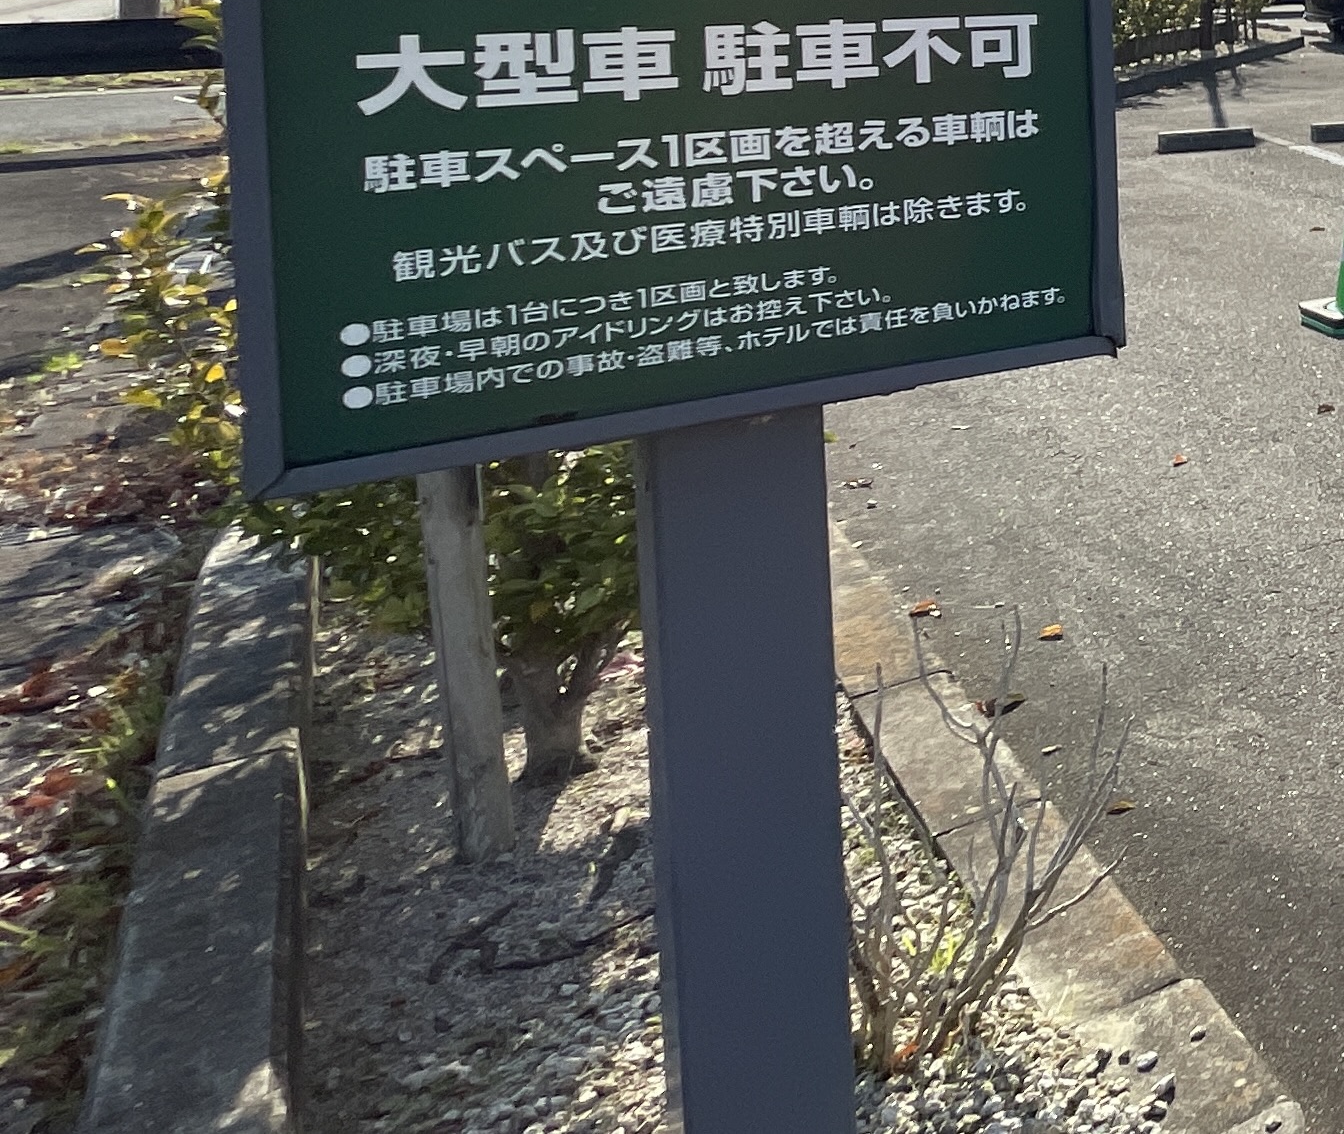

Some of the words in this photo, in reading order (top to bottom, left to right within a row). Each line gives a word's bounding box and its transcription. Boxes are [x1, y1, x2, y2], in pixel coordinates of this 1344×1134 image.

[355, 26, 679, 116] 大型車
[702, 14, 1038, 96] 駐車不可
[597, 164, 874, 214] ご遠慮下さい。
